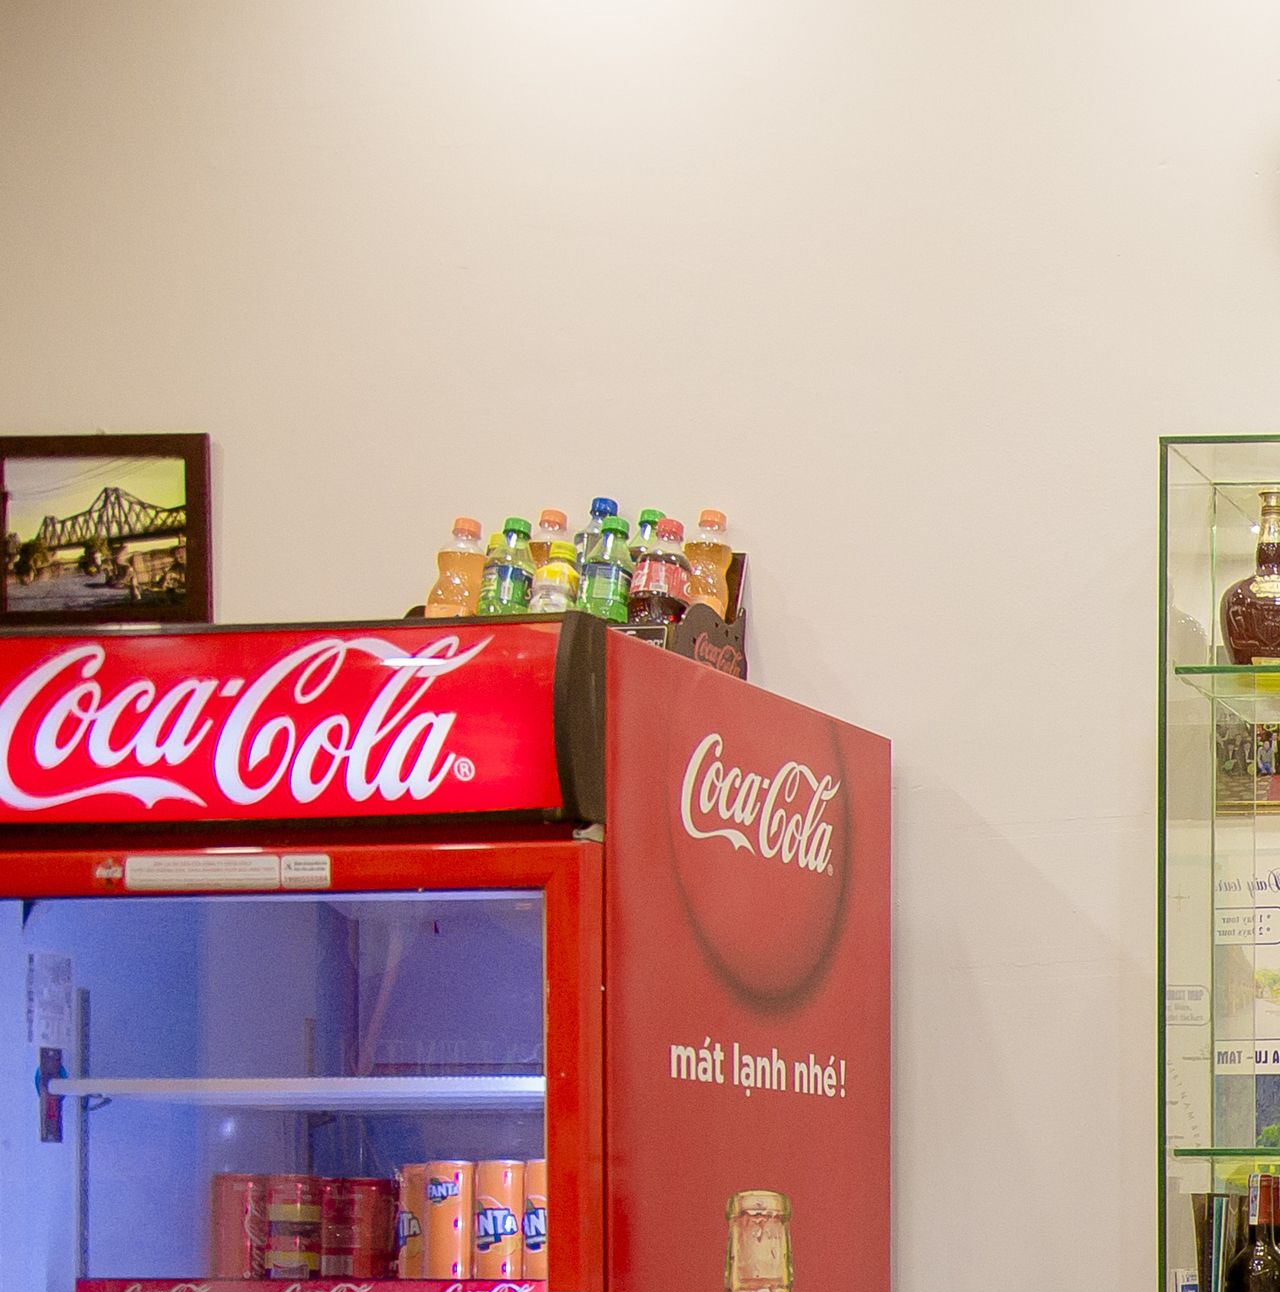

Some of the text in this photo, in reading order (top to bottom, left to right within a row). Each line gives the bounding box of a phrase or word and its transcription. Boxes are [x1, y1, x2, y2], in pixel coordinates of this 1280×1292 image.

[0, 636, 493, 811] Coca-Cola
[681, 733, 841, 873] Coca-Cola
[671, 1037, 846, 1098] mát lạnh nhé!
[426, 1182, 459, 1199] FANTA
[477, 1208, 518, 1238] NTA
